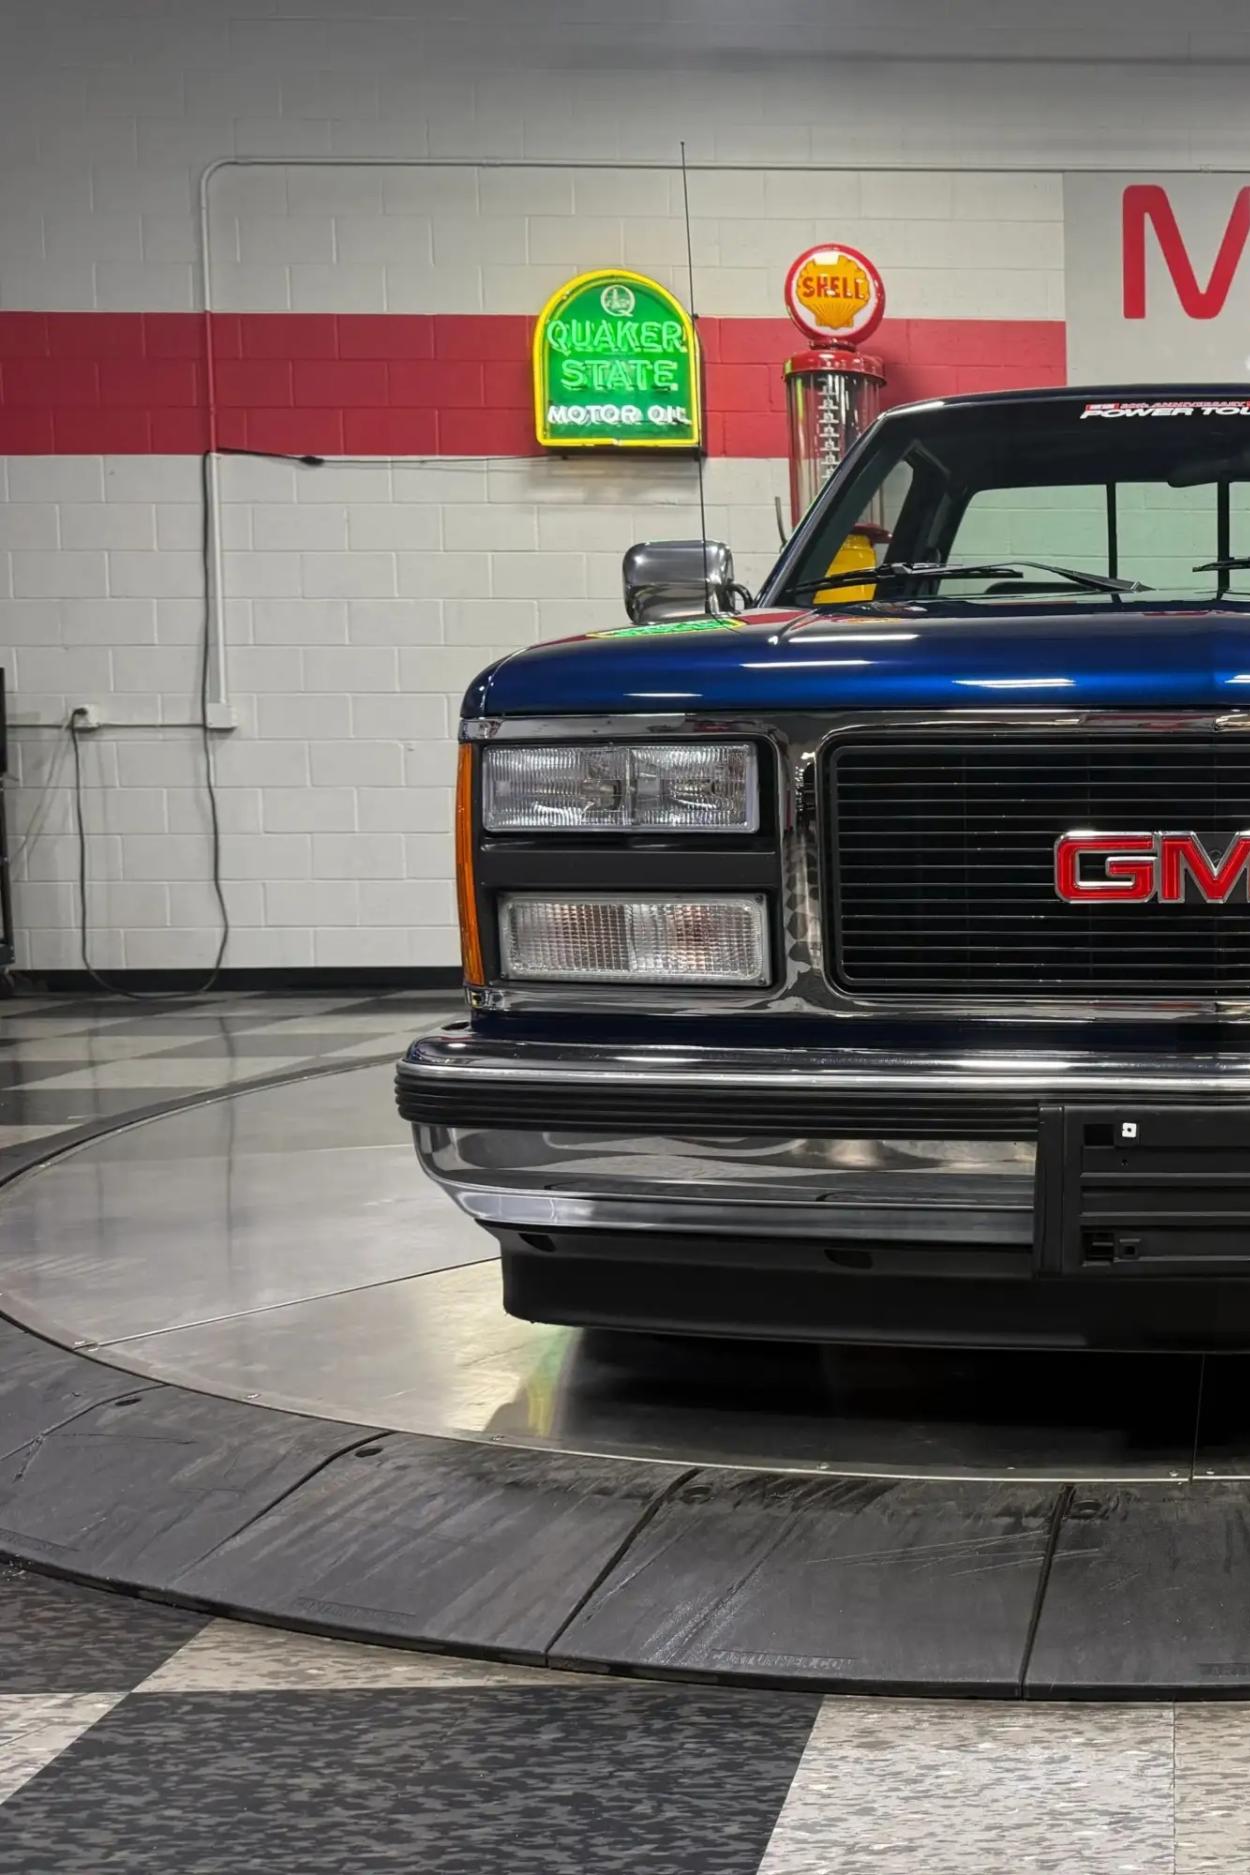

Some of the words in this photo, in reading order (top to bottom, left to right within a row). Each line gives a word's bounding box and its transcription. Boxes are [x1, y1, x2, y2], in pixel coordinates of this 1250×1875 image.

[801, 276, 866, 300] SHELL
[547, 319, 688, 356] QUAKER
[560, 359, 679, 391] STATE
[547, 405, 643, 425] MOTOR
[647, 405, 691, 425] OIL
[1080, 407, 1194, 419] POWER
